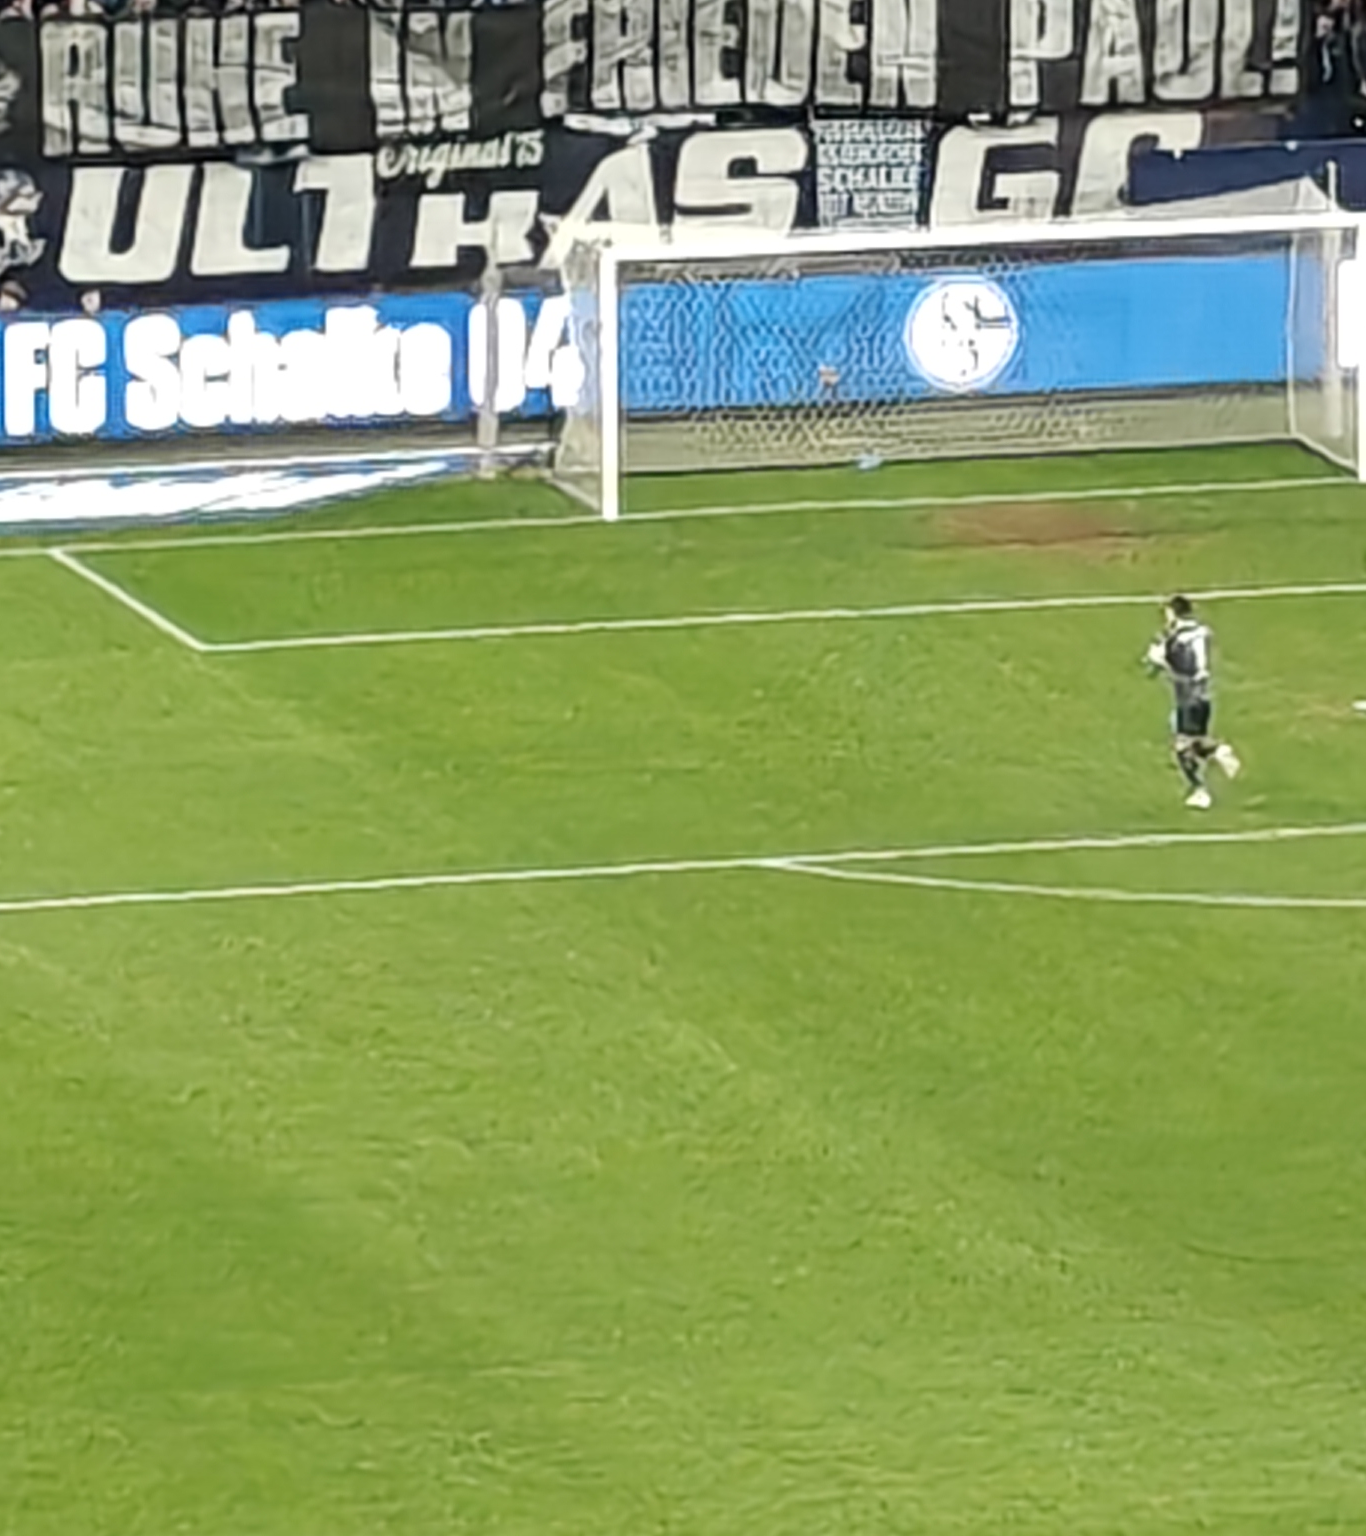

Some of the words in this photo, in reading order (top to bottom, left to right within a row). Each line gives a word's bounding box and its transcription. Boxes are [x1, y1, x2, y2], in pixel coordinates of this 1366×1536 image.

[40, 11, 311, 158] RUHE
[369, 9, 473, 138] IN
[59, 128, 808, 283] ULTRAS
[3, 317, 107, 437] FC
[124, 304, 452, 431] Schalke
[468, 295, 585, 412] 04
